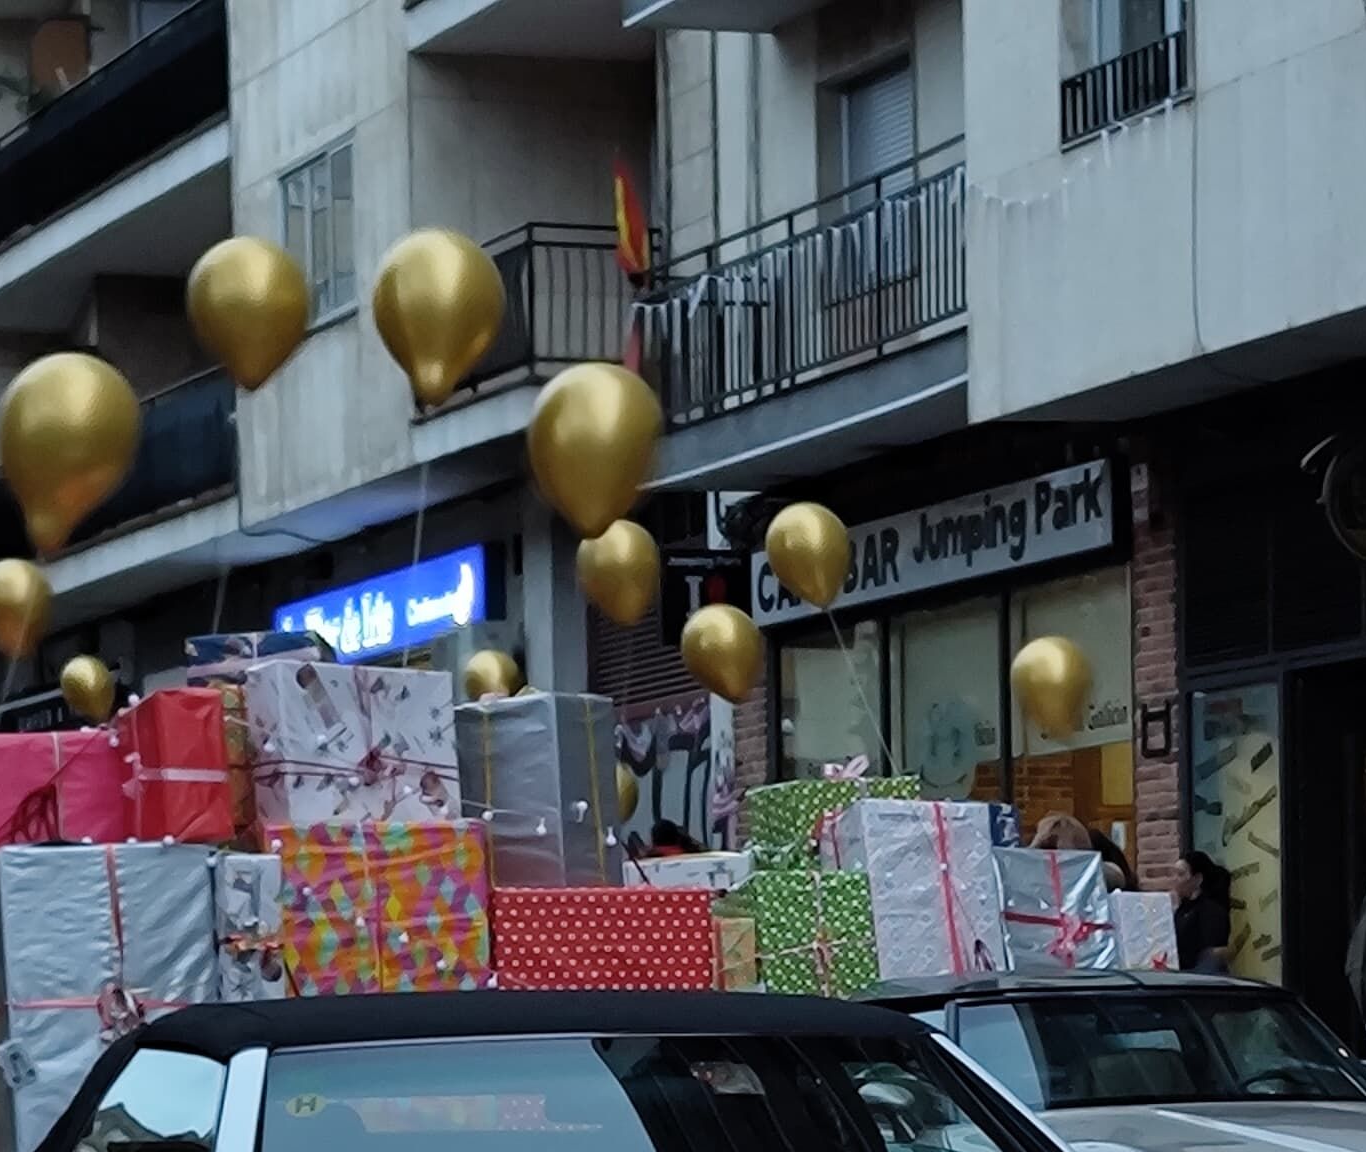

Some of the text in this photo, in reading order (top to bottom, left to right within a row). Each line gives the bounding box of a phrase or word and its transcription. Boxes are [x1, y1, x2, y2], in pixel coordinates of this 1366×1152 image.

[912, 494, 1027, 568] Jumping
[1035, 468, 1104, 535] Park
[295, 1096, 317, 1114] H
